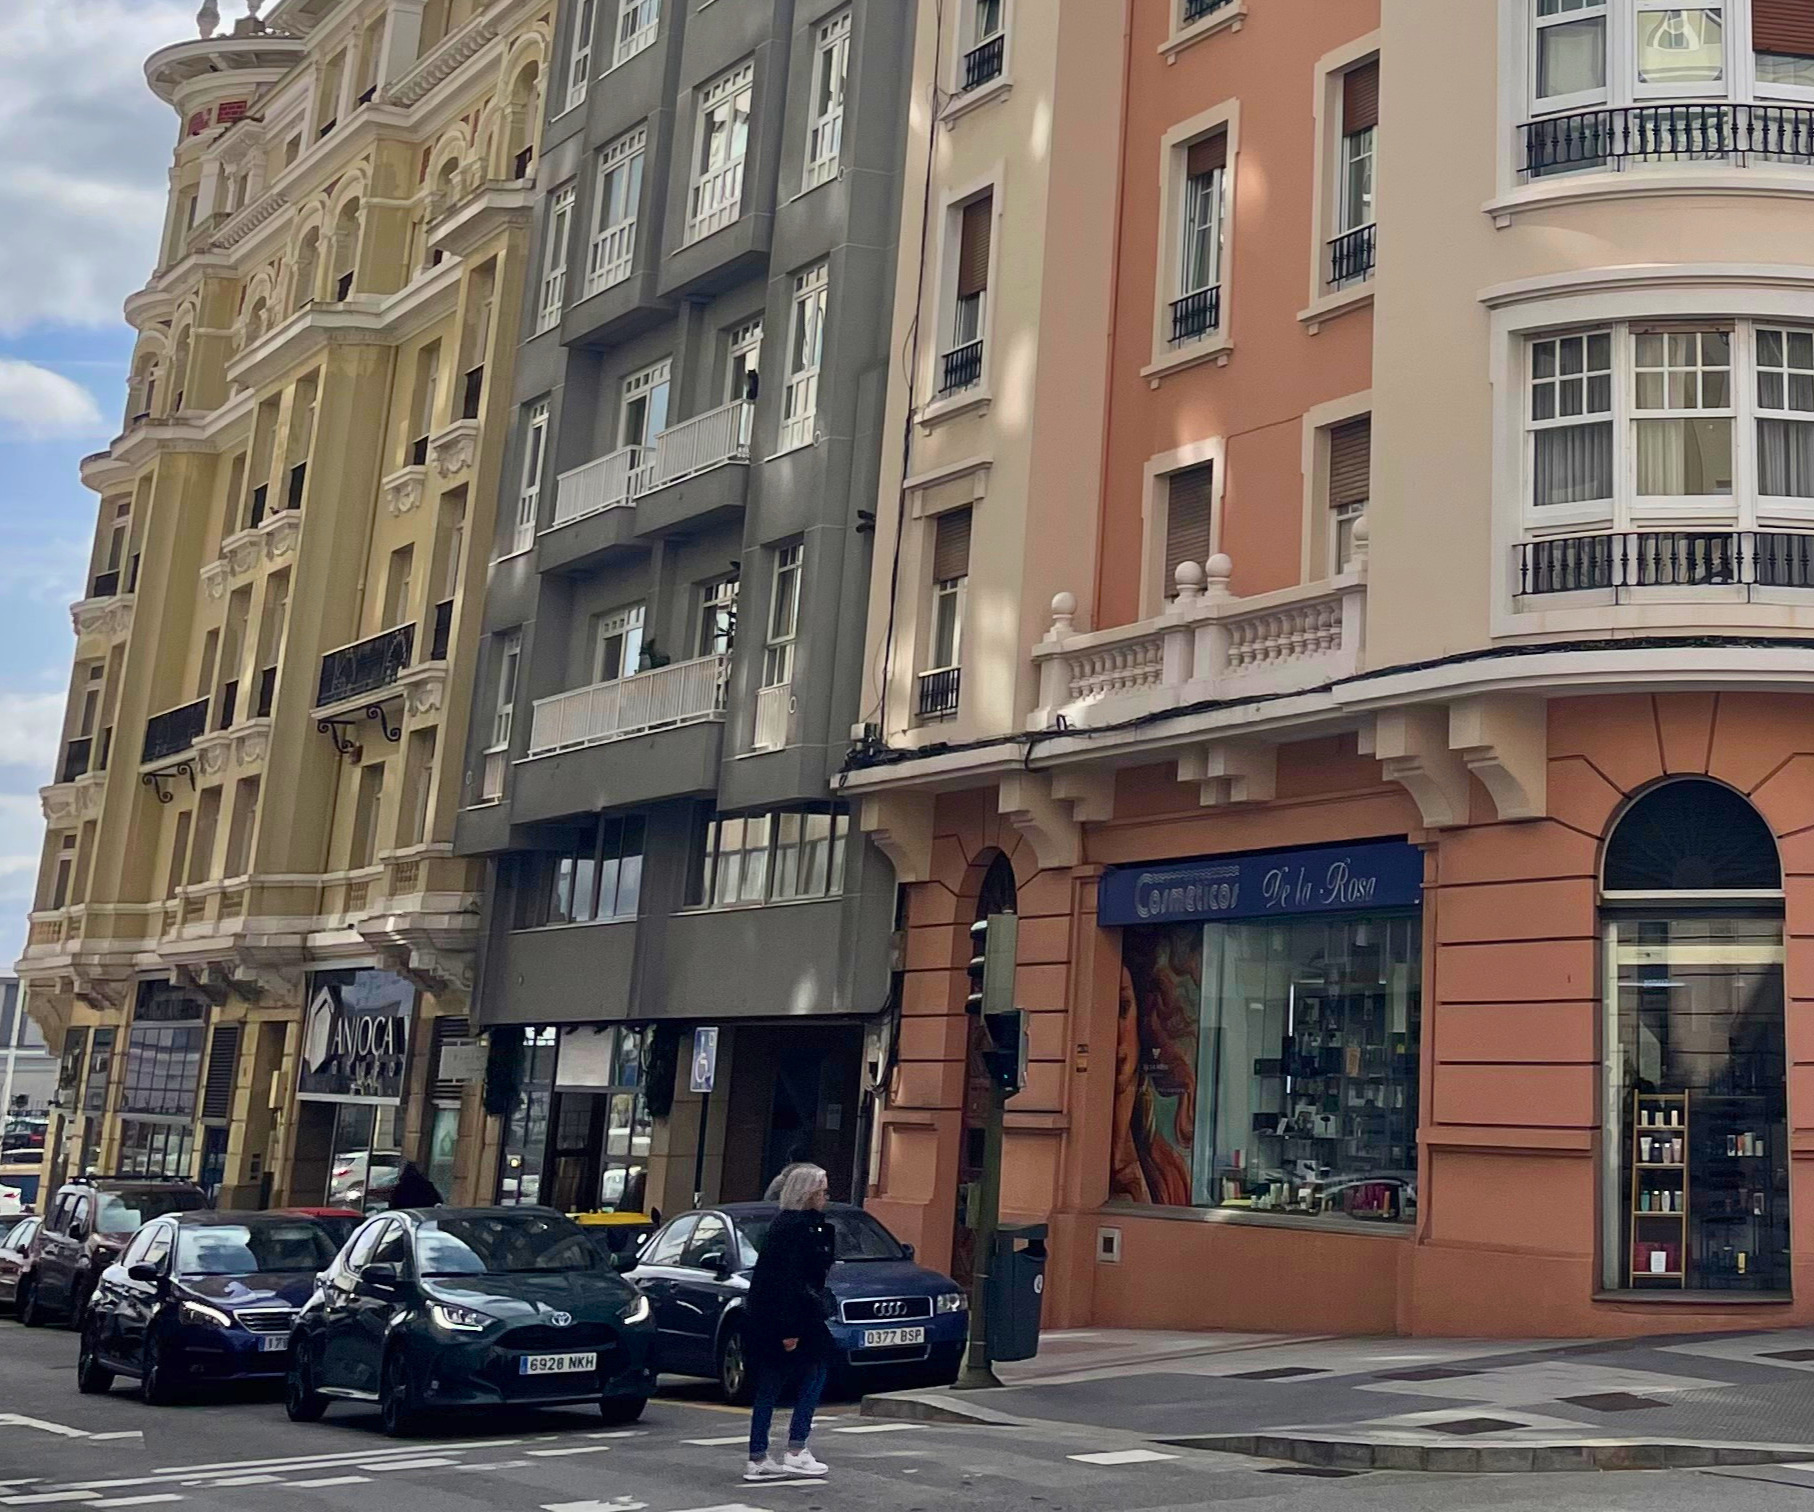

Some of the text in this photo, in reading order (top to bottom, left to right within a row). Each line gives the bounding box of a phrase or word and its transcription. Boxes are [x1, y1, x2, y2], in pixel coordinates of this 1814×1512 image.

[1263, 866, 1289, 908] De
[1295, 867, 1313, 906] la
[867, 1329, 921, 1344] 0377 BSP
[568, 1355, 594, 1369] NKH
